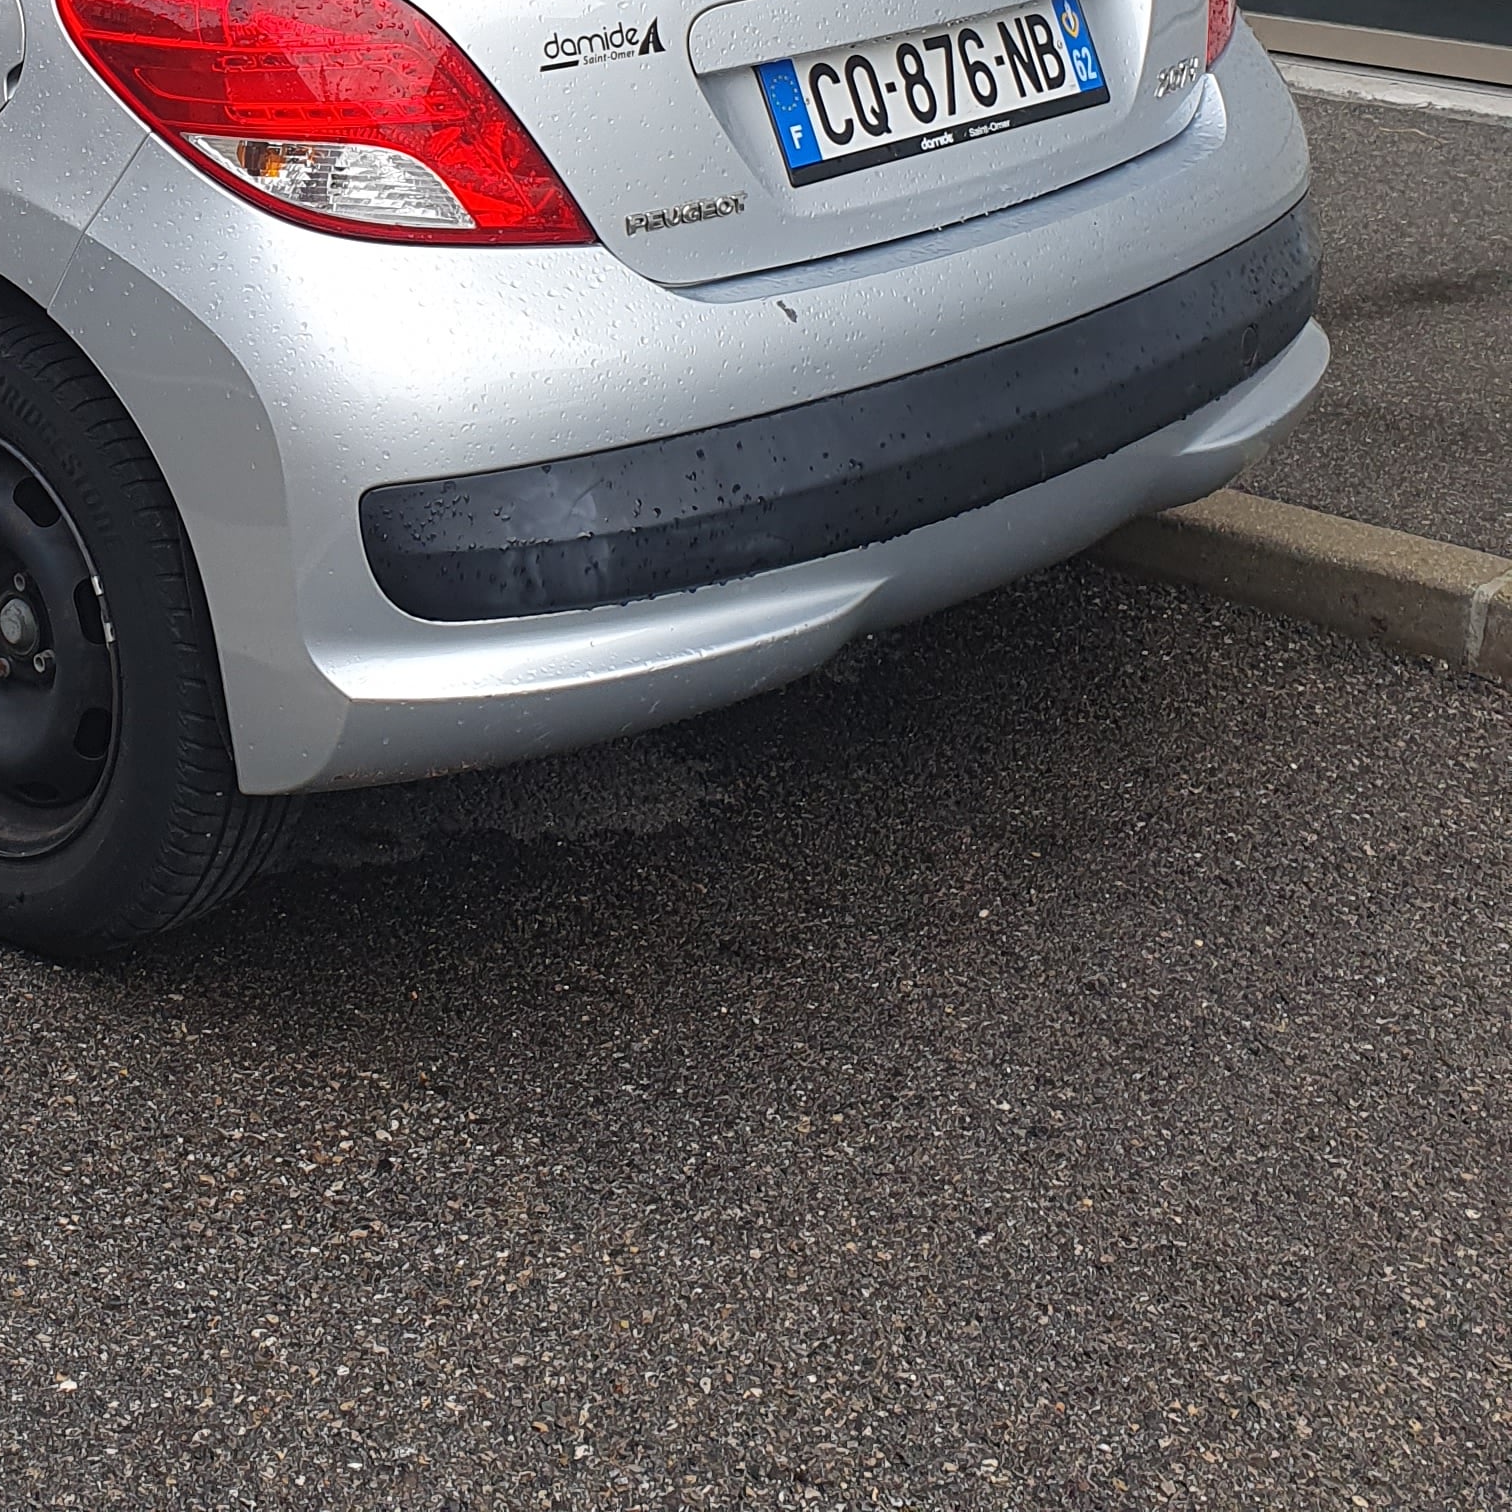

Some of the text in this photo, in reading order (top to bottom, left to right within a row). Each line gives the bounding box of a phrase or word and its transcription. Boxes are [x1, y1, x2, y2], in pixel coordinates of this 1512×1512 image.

[543, 21, 640, 60] damide
[583, 50, 636, 66] Saint-Omer
[789, 13, 1098, 150] F CQ-876-NB 62
[625, 190, 748, 237] PEUGEOT
